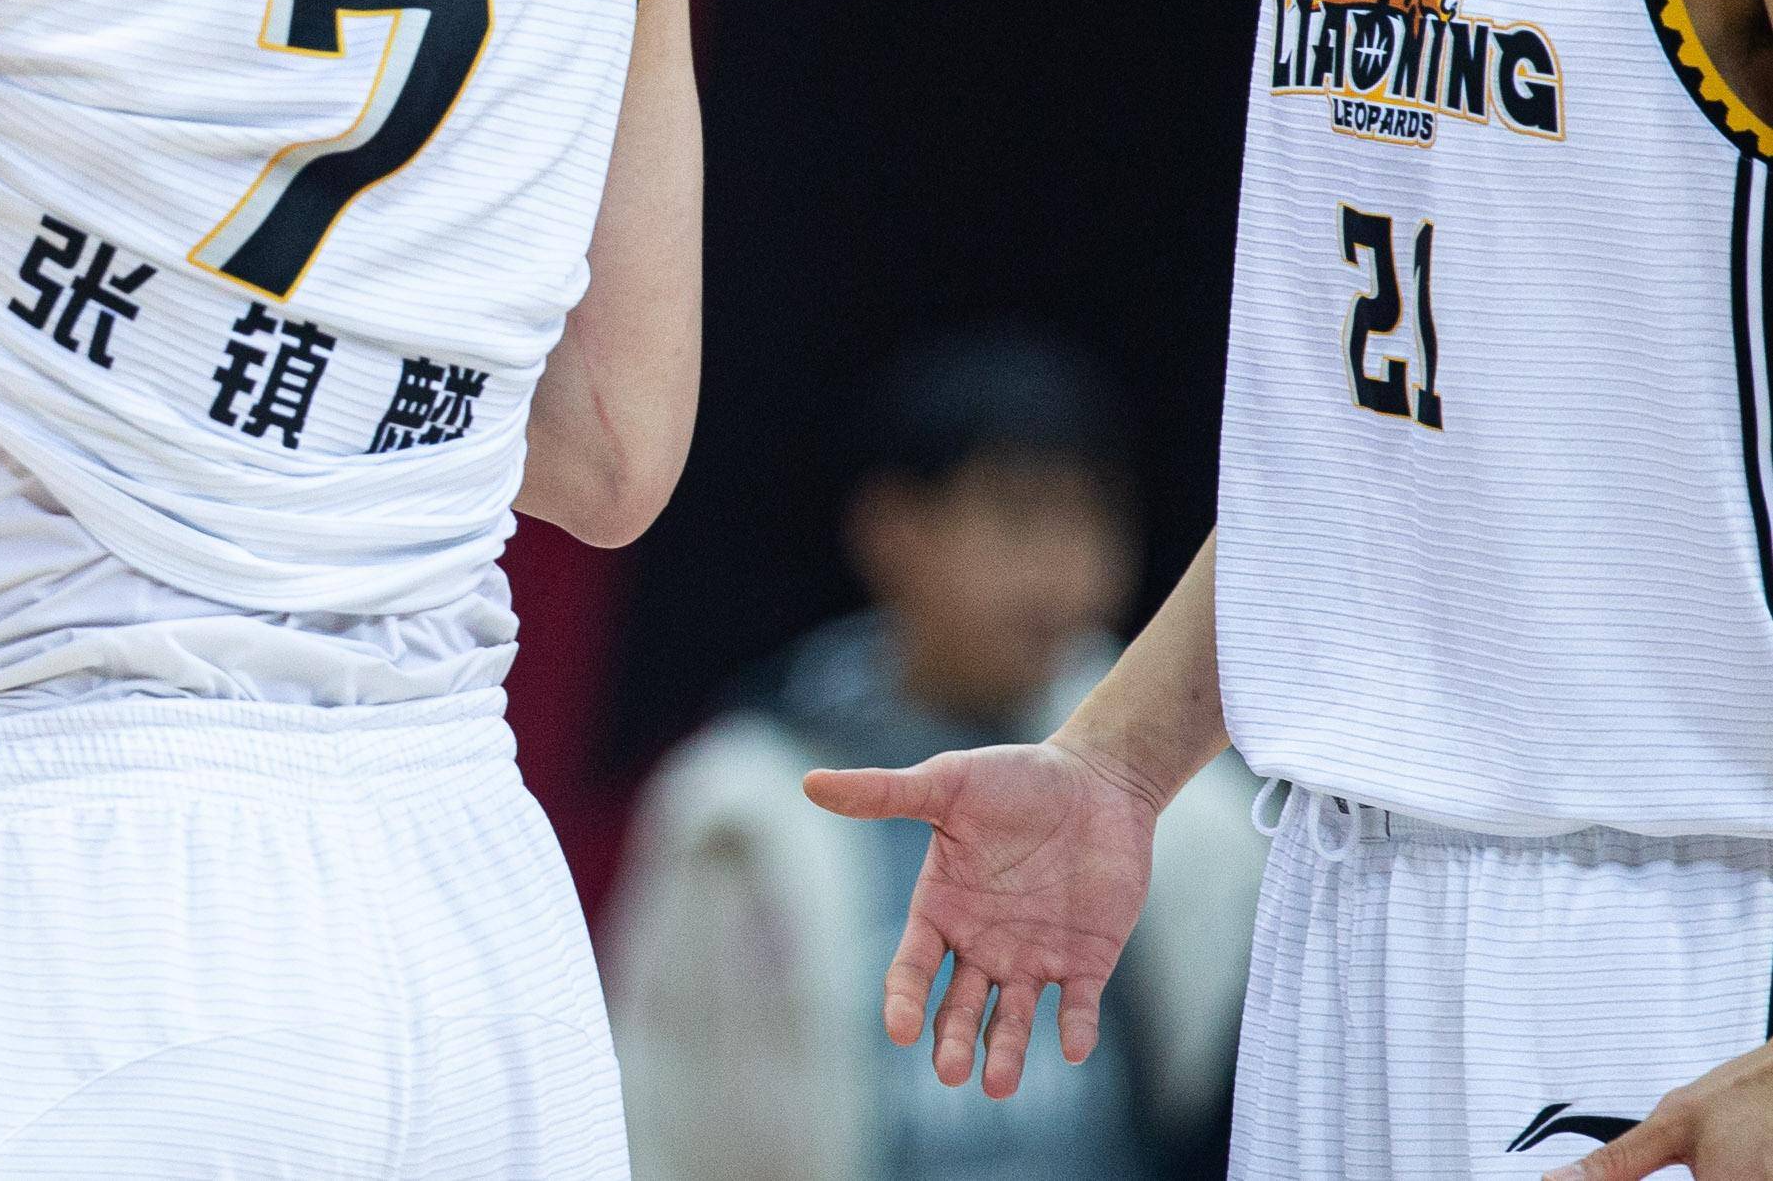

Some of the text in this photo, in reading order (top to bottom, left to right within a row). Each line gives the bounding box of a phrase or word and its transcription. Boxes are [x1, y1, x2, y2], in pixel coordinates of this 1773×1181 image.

[1332, 97, 1435, 141] LEOPARDS
[8, 214, 490, 455] 张镇麟
[1337, 202, 1444, 431] 21
